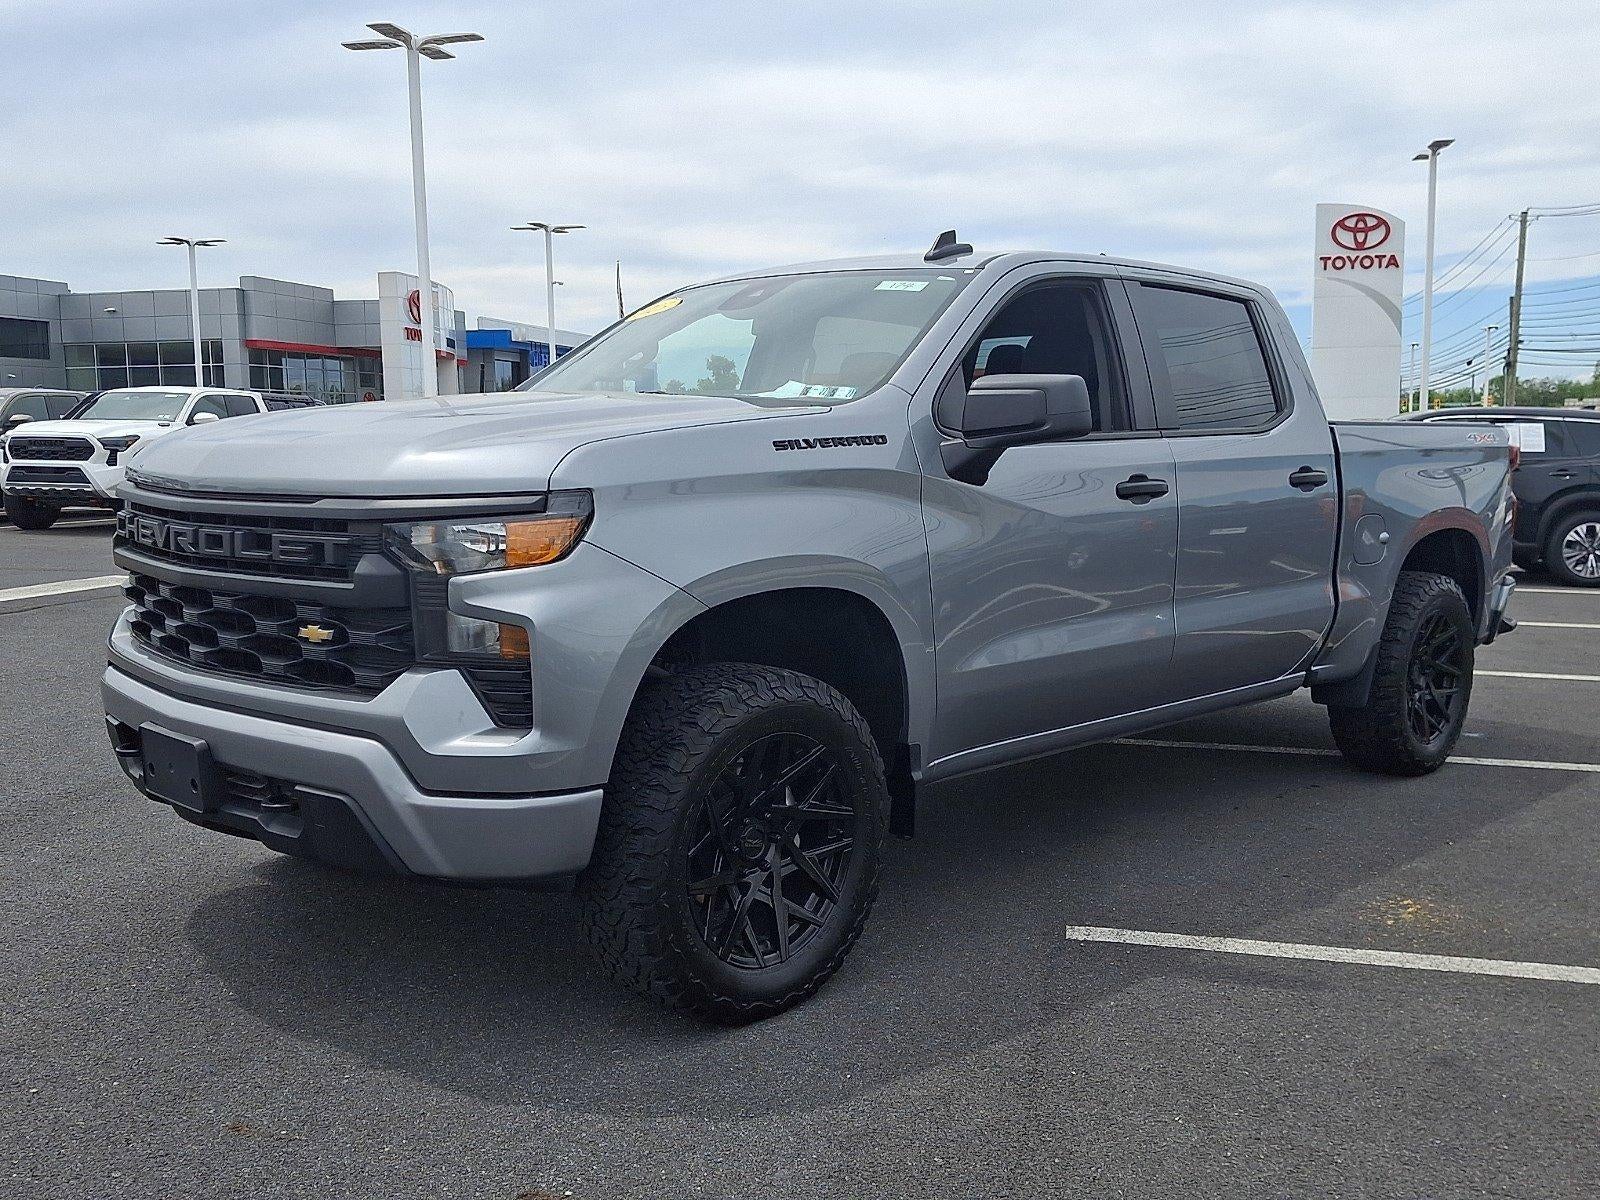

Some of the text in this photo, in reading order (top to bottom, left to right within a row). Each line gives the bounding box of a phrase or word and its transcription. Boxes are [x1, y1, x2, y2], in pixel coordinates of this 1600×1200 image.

[1319, 254, 1400, 271] TOYOTA
[772, 434, 888, 451] SILVERADO
[116, 509, 350, 567] CHEVROLET
